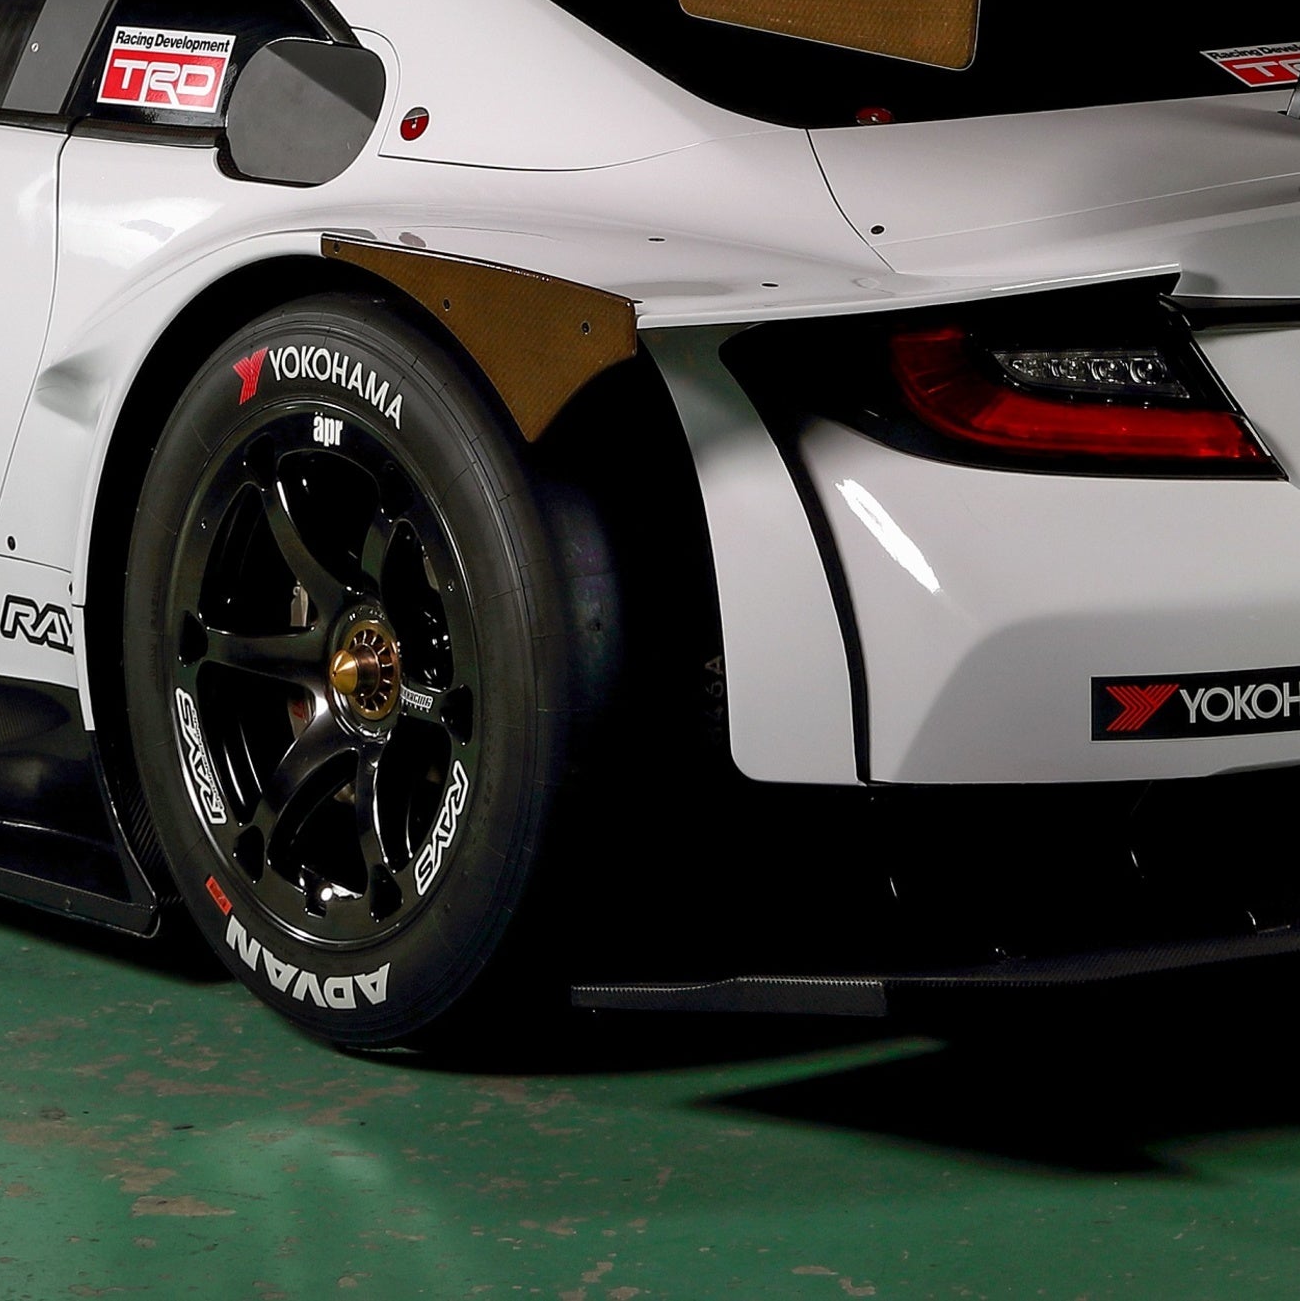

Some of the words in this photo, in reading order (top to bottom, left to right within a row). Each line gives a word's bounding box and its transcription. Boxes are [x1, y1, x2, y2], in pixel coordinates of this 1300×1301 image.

[113, 58, 216, 107] TRD
[116, 31, 154, 48] Racing
[155, 34, 230, 53] Development
[269, 345, 403, 429] YOKOHAMA
[414, 760, 469, 896] RAYS
[226, 914, 391, 1010] ADVAN
